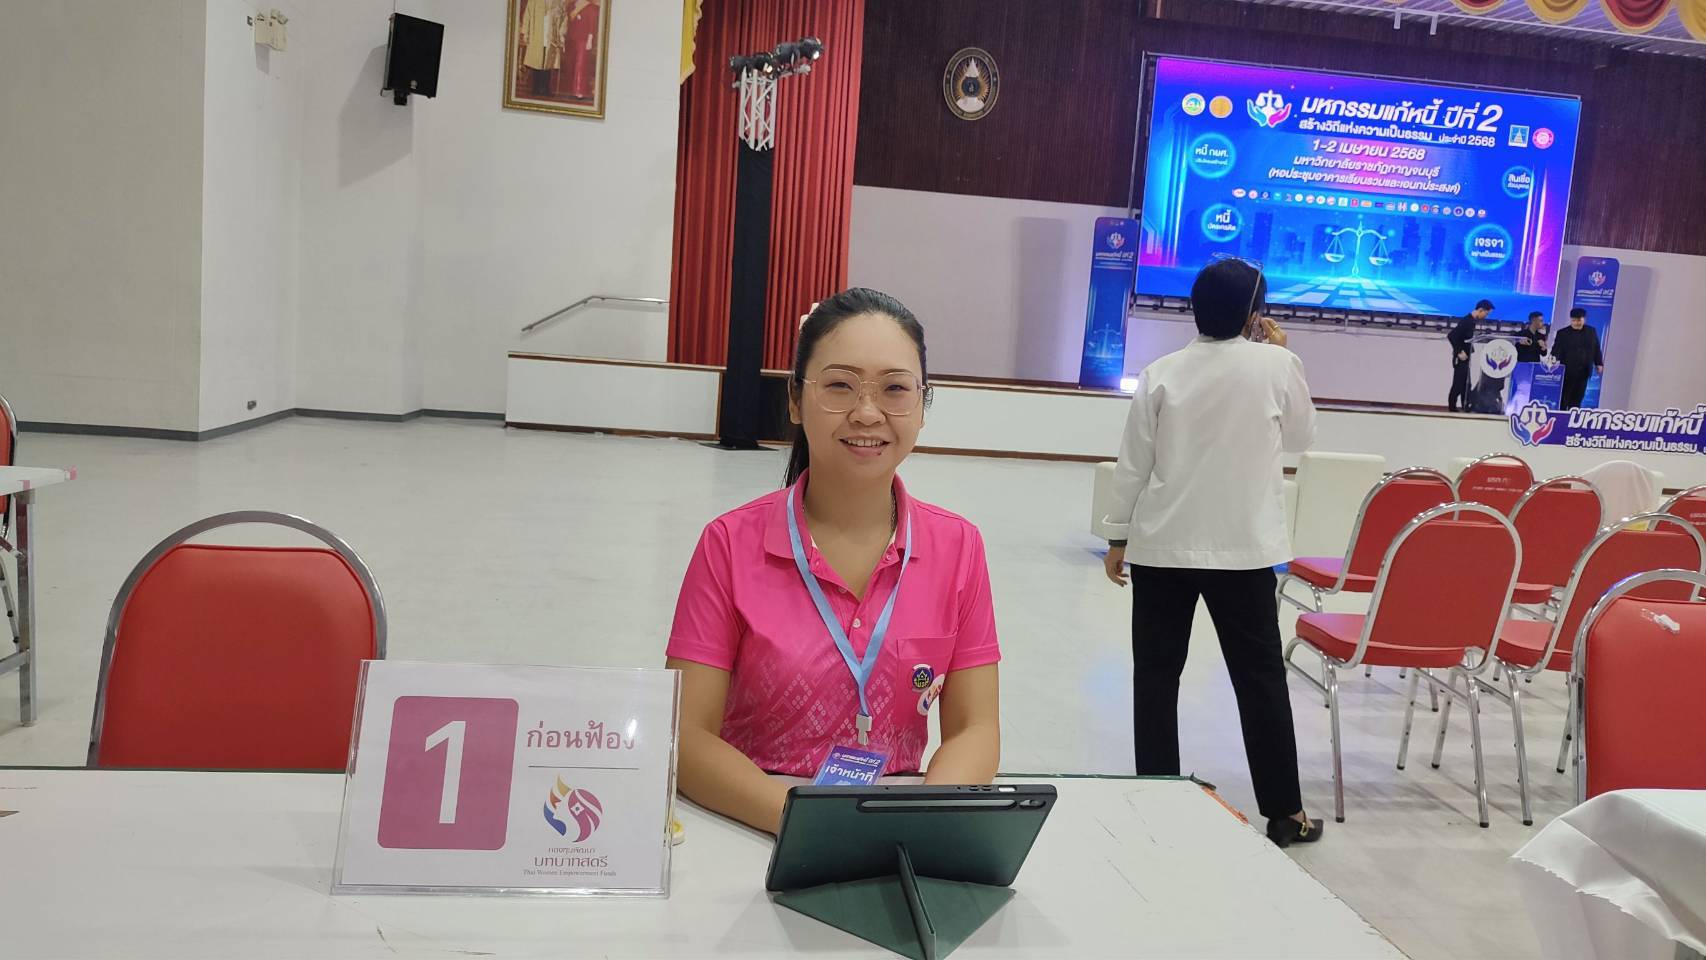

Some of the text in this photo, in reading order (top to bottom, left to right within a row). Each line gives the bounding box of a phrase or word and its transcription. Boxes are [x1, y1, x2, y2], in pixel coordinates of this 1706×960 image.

[1301, 97, 1503, 132] มหกรรมแก้หนี้ ปีที่ 2
[1299, 117, 1433, 141] สร้างวิถีแห่งความเป็นธรรม
[1468, 134, 1496, 147] 2568
[1195, 144, 1229, 158] หนี้ กยศ.
[1312, 139, 1426, 160] 1-2 เมษายน 2568
[1293, 156, 1440, 180] มหาวิทยาลัยราชภัฏกาญจนบุรี
[1215, 209, 1231, 224] หนี้
[1474, 237, 1504, 249] เจรจา
[1567, 405, 1706, 435] มหกรรมแก้หนี้
[1565, 433, 1698, 453] สร้างวิถีแห่งความเป็นธรรม
[425, 720, 466, 824] 1
[825, 763, 877, 782] เจ้าหน้าที่
[534, 855, 608, 868] บทบาทสตรี
